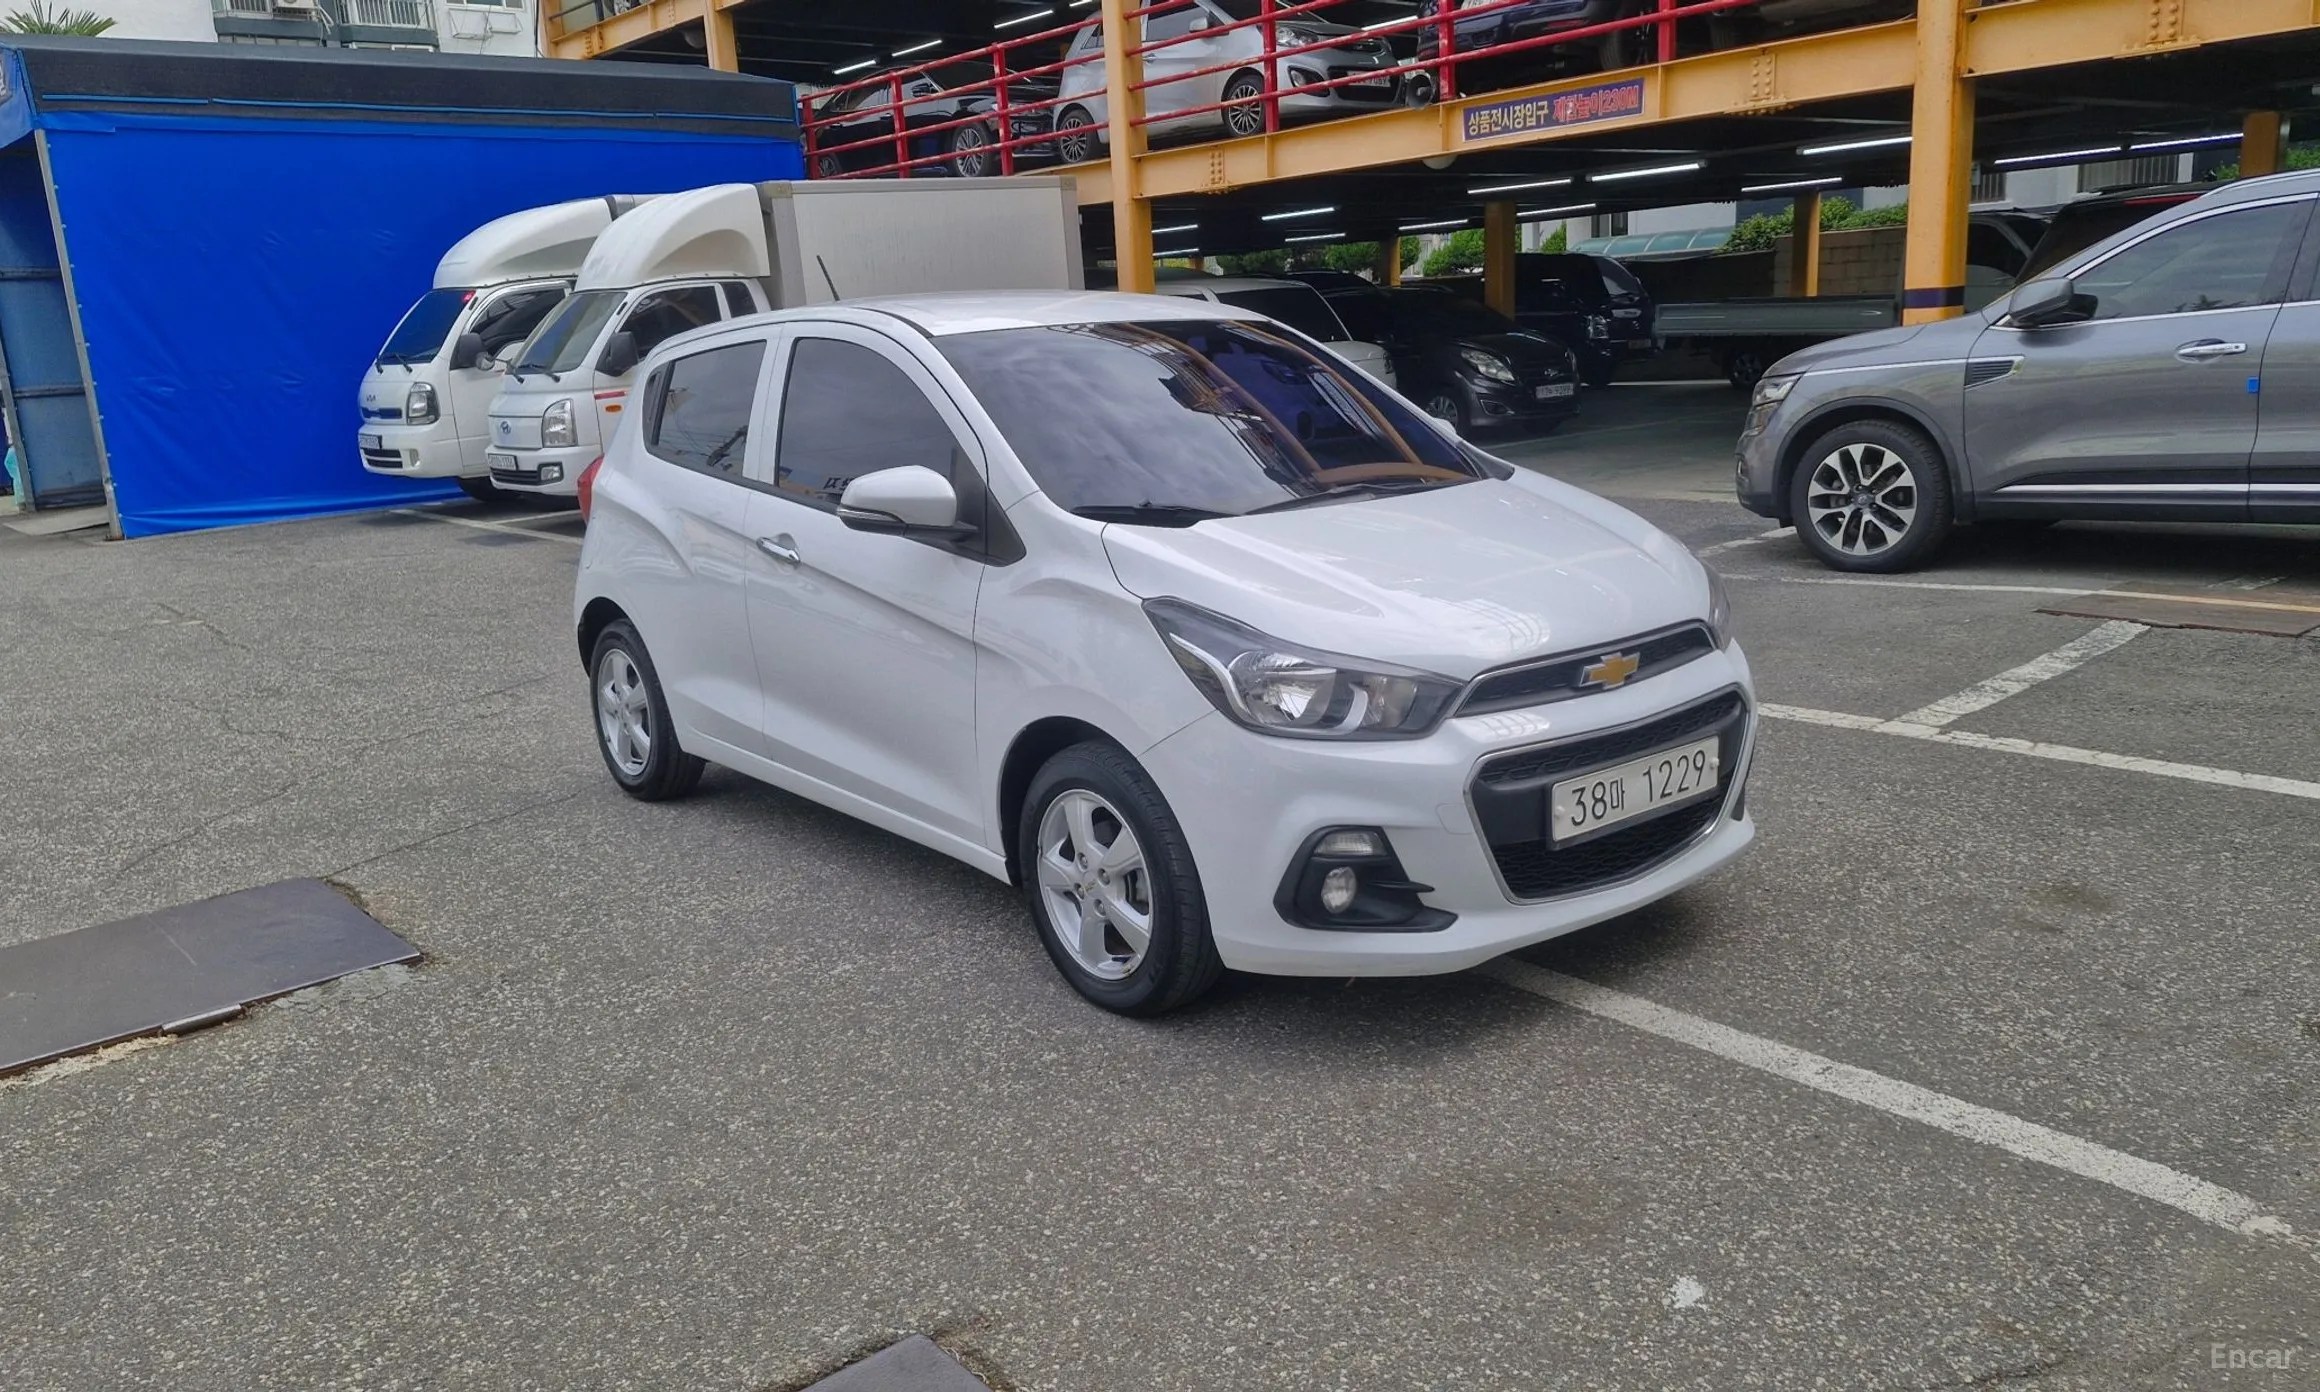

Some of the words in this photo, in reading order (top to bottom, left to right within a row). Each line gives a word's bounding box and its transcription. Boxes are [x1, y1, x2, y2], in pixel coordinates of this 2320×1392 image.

[1468, 101, 1548, 135] 상품전시장입구
[1571, 778, 1625, 826] 38마
[1642, 750, 1706, 802] 1229
